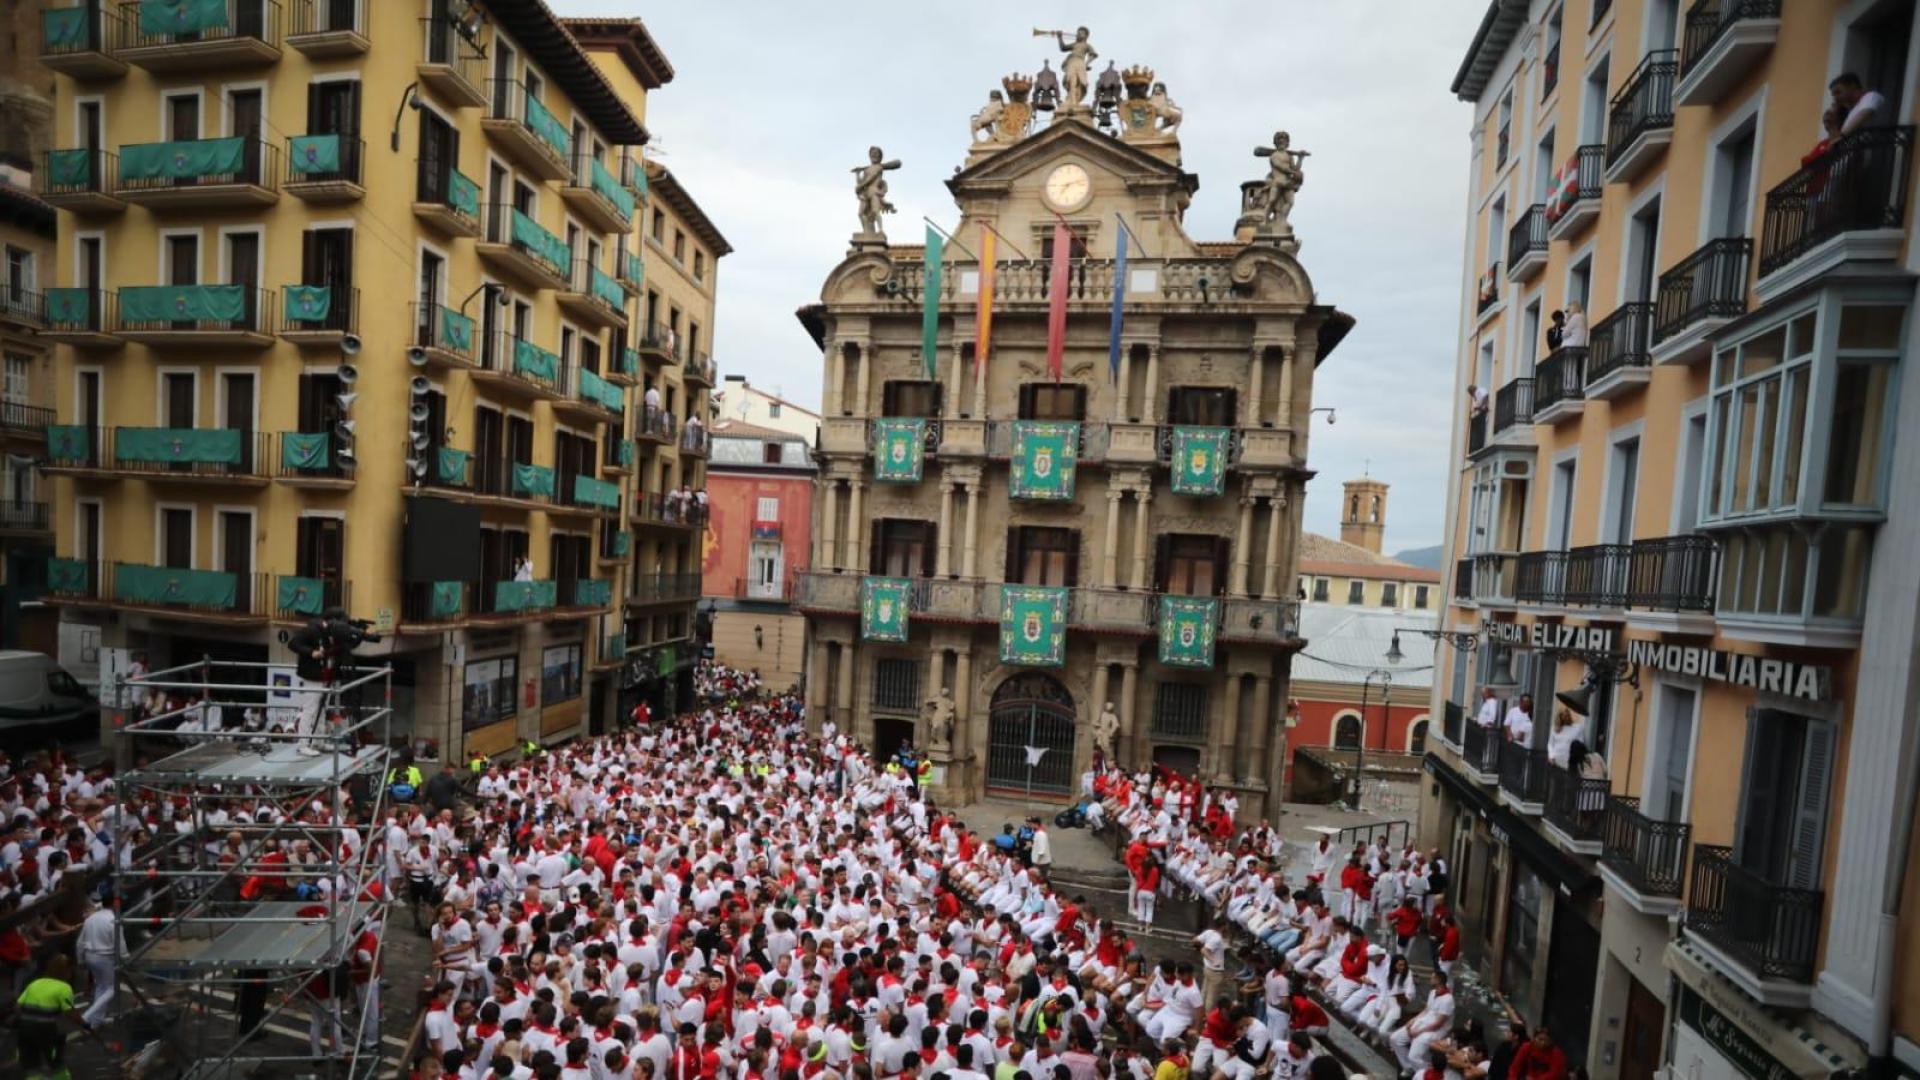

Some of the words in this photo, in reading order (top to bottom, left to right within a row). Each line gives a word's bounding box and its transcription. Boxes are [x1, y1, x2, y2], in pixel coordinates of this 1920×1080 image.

[1531, 623, 1612, 657] ELIZARI
[1627, 640, 1819, 700] INMOBILIARIA
[1635, 946, 1641, 963] 2
